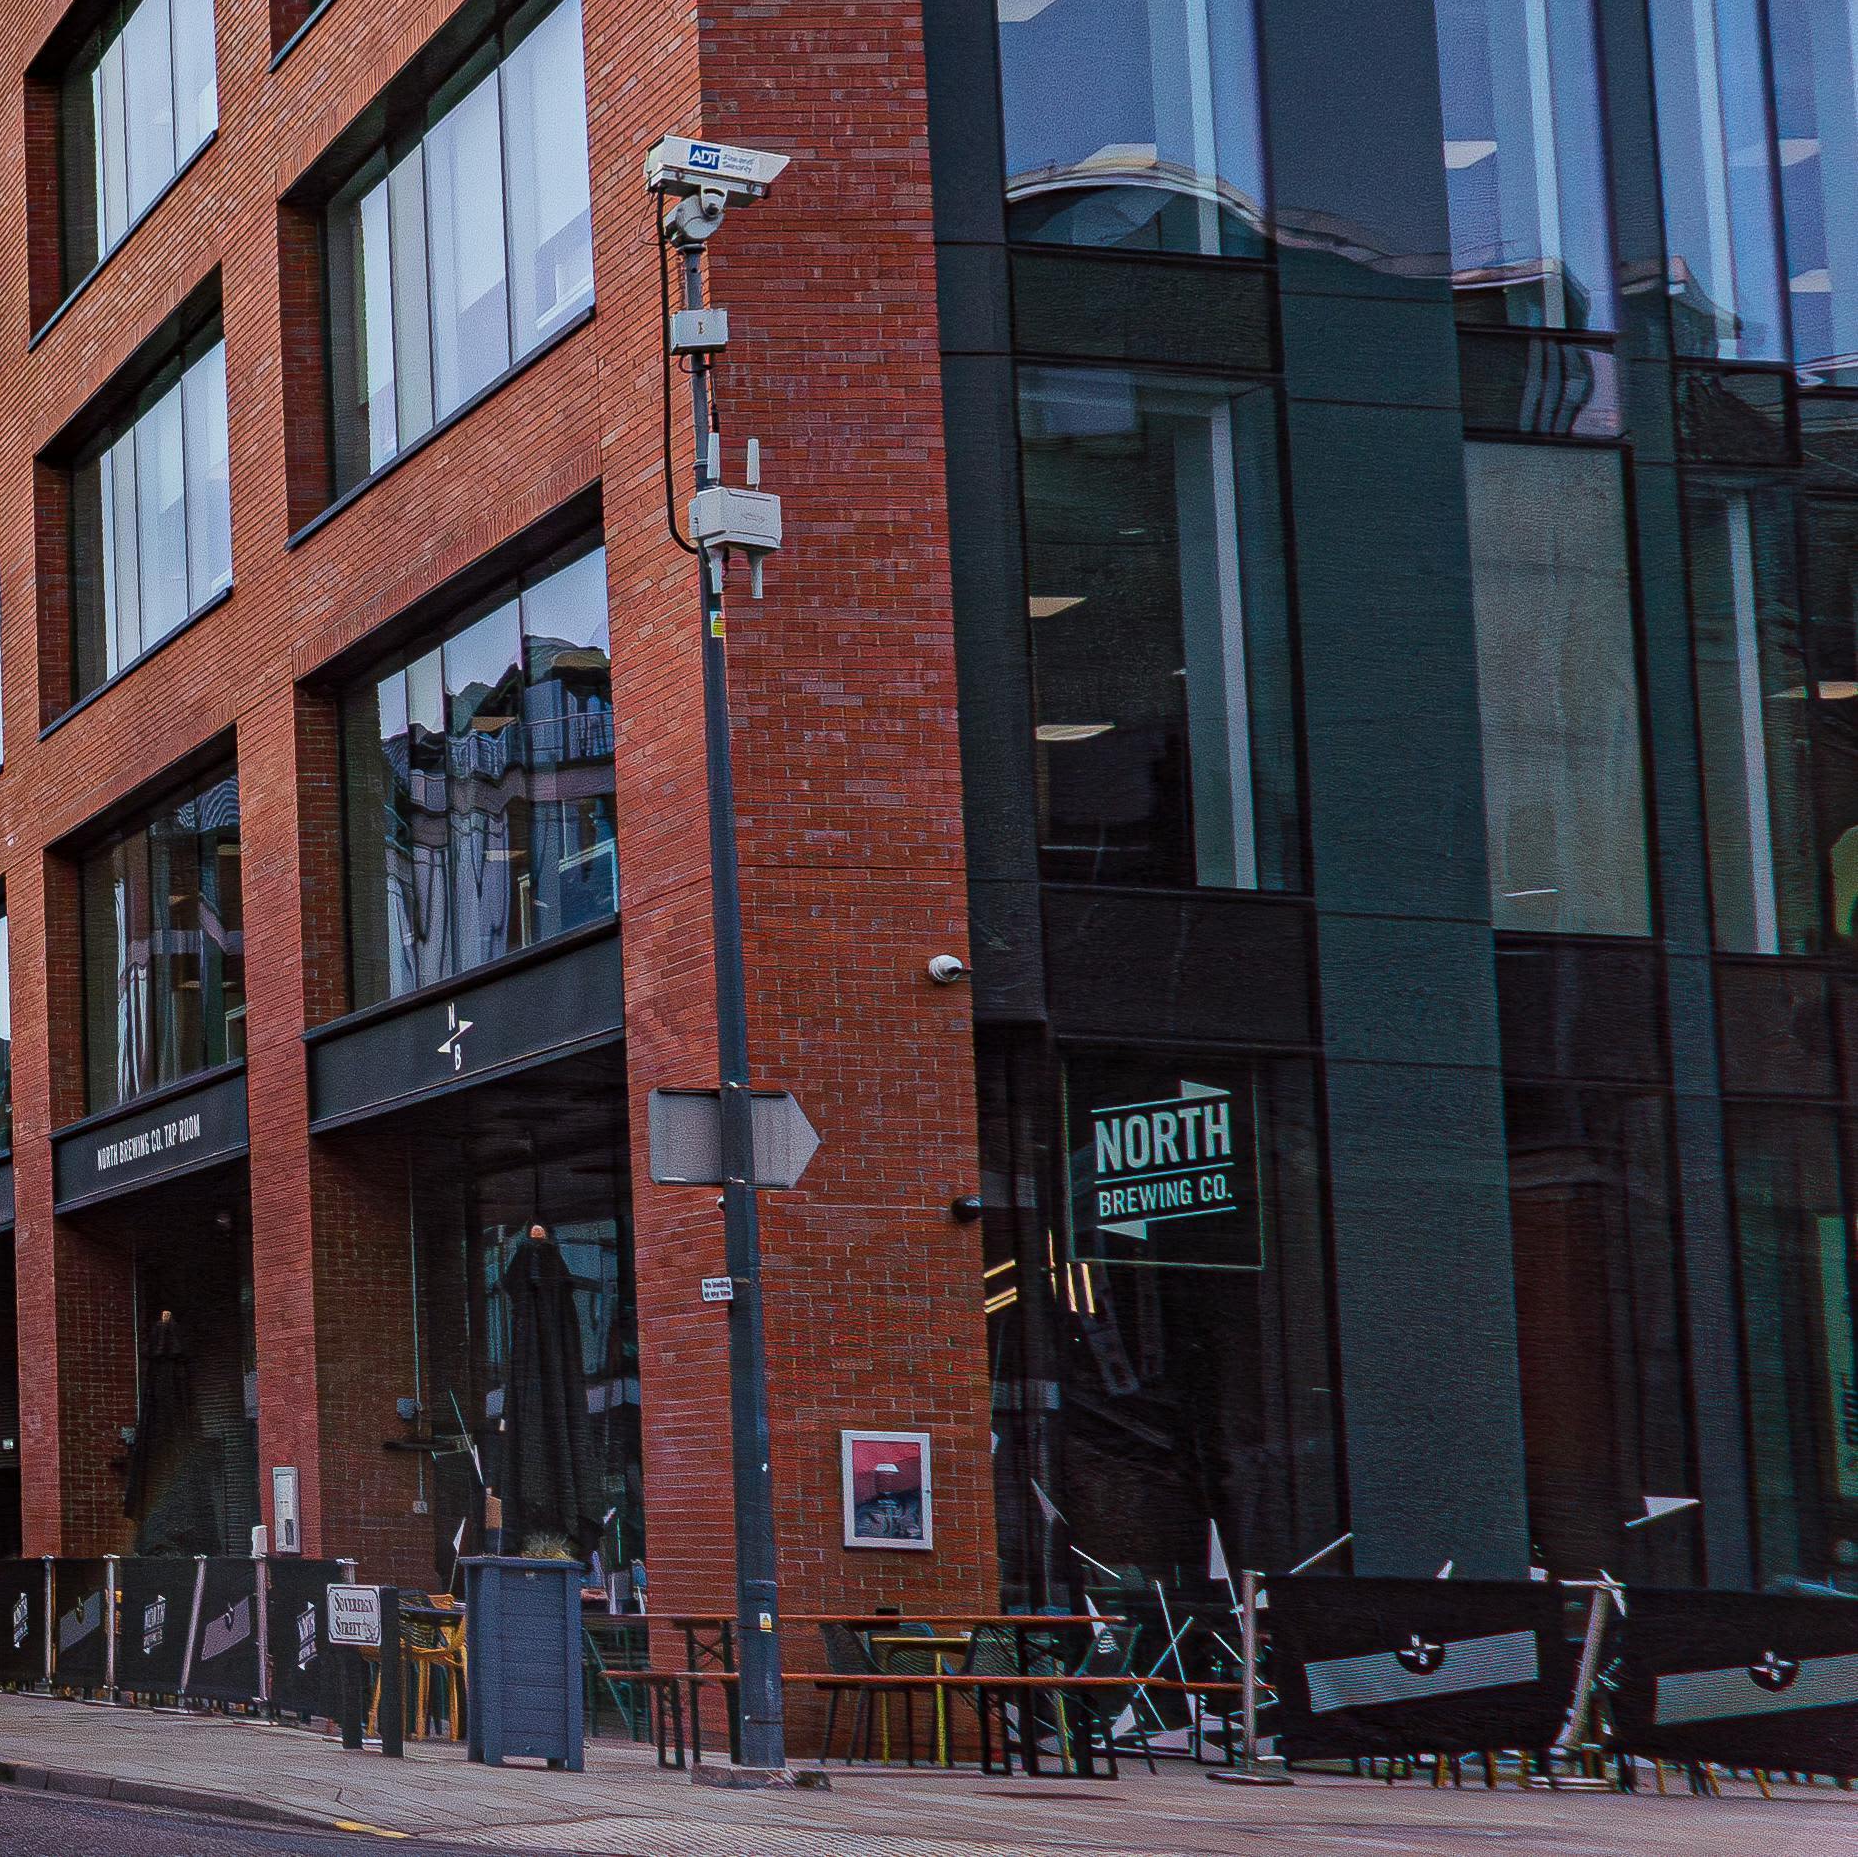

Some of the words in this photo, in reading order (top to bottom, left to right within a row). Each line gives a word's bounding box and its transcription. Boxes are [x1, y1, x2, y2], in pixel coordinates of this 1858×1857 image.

[690, 149, 721, 166] ADT
[97, 1143, 119, 1171] NORTH
[119, 1133, 150, 1163] BREWING
[151, 1128, 164, 1154] CO.
[164, 1122, 178, 1148] TAP
[179, 1113, 201, 1143] ROOM
[1095, 1103, 1232, 1173] NORTH
[1098, 1179, 1193, 1218] BREWING
[1200, 1173, 1233, 1203] CO.
